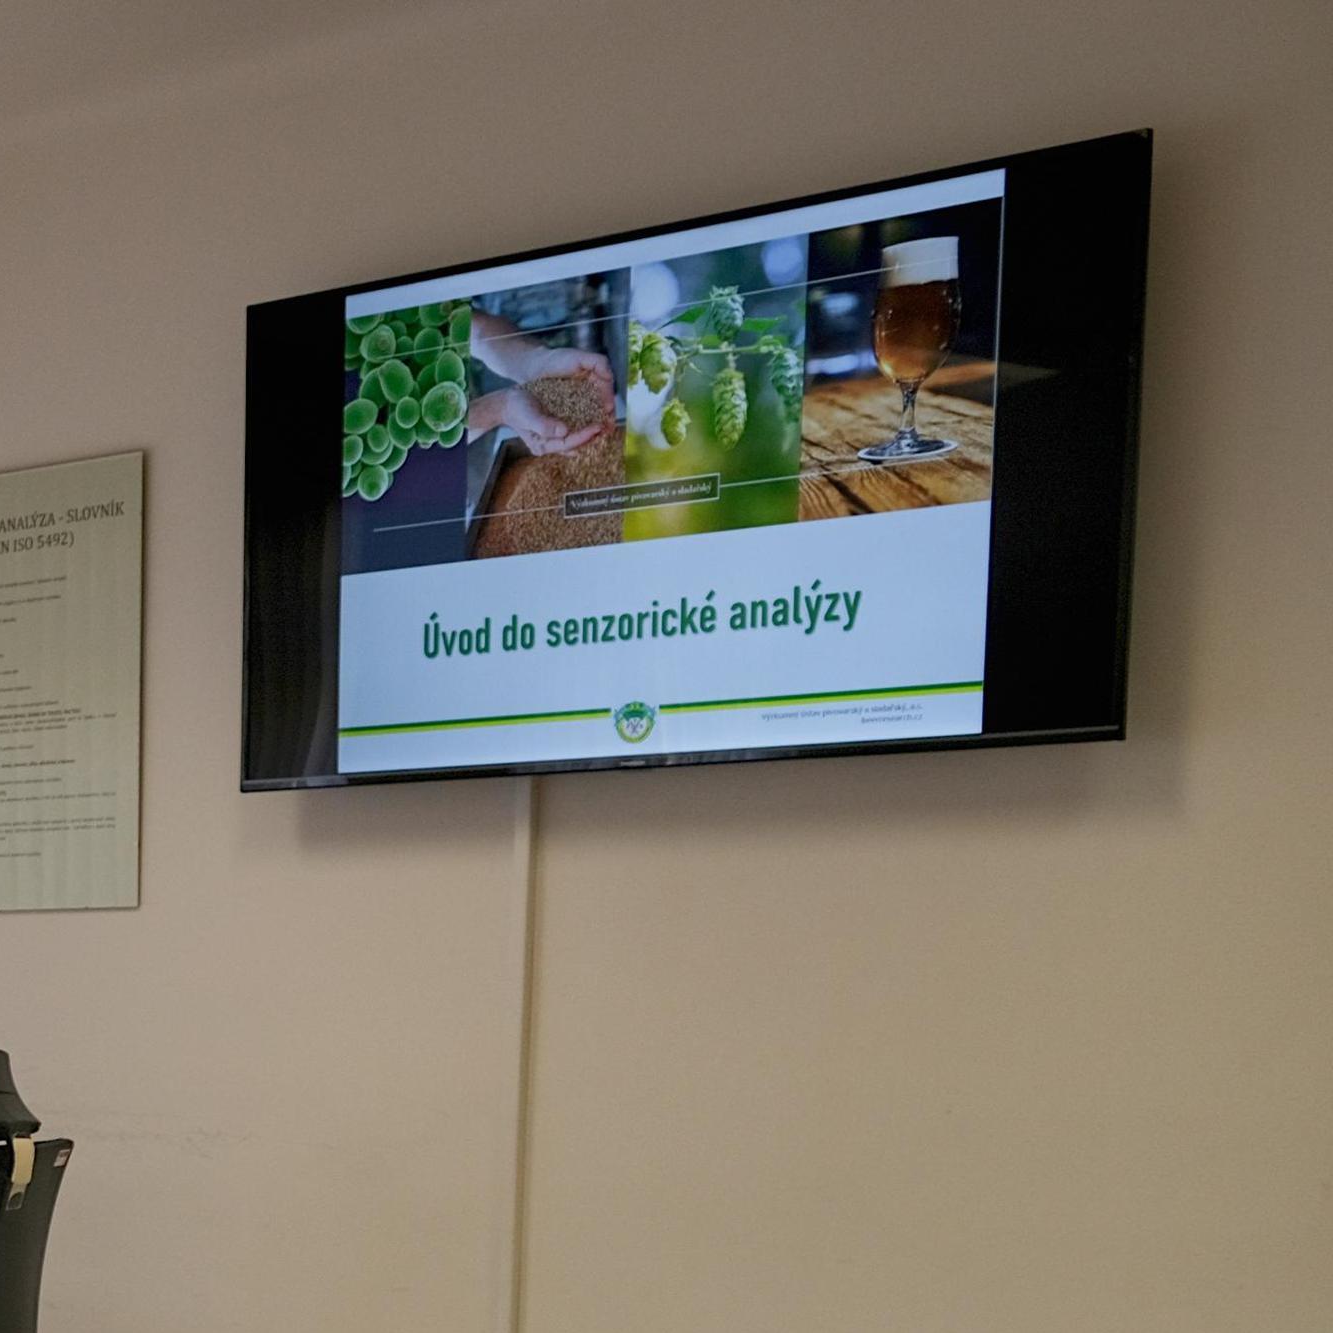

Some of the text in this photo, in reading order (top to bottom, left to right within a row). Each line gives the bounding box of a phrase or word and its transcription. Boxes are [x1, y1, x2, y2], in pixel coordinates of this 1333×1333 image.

[66, 499, 125, 524] SLOVNÍK
[13, 536, 33, 553] ISO
[37, 531, 75, 549] 5492)
[423, 579, 863, 660] Úvod do senzorické analýzy
